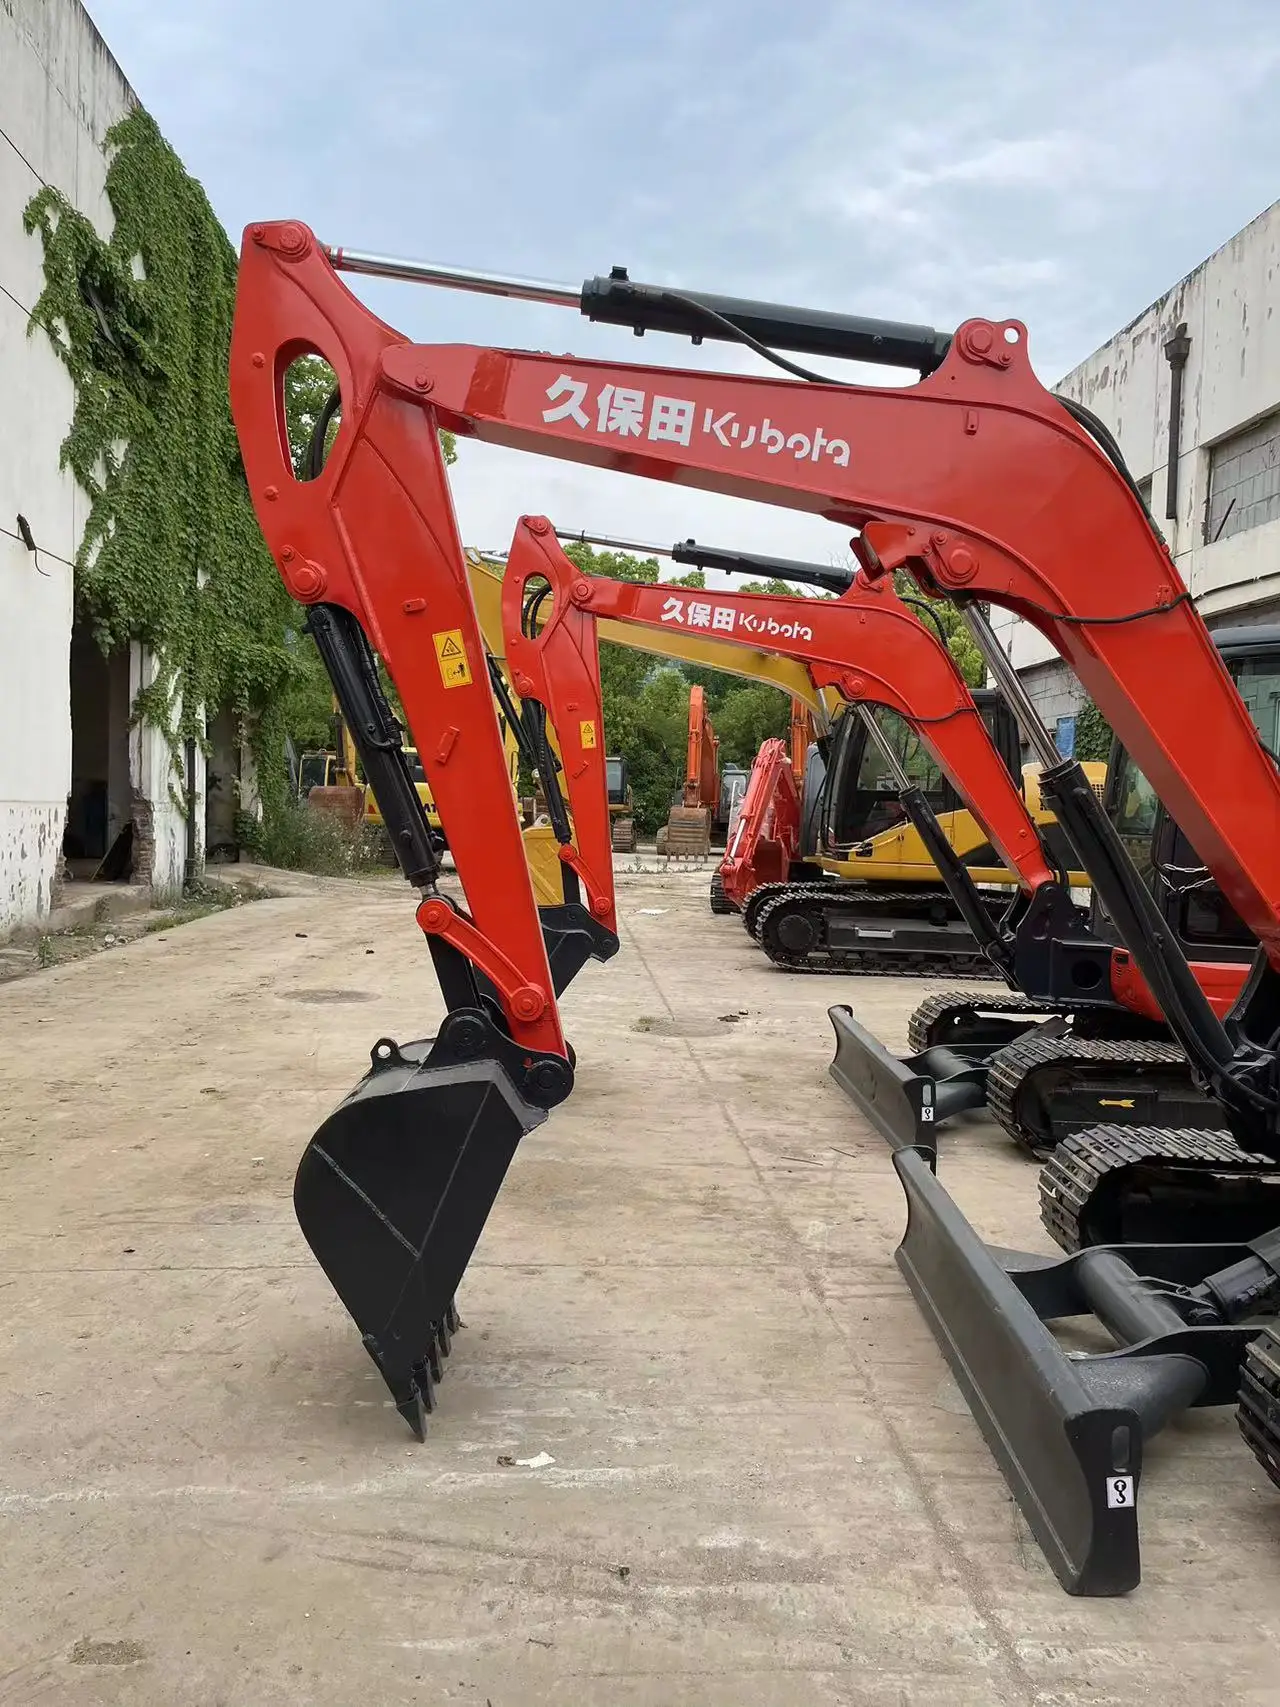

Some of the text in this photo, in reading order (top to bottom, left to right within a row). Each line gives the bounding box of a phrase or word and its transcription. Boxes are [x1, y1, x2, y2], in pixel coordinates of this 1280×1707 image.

[542, 374, 850, 467] 久保田 Kubota
[660, 597, 813, 641] 久保田 Kubota
